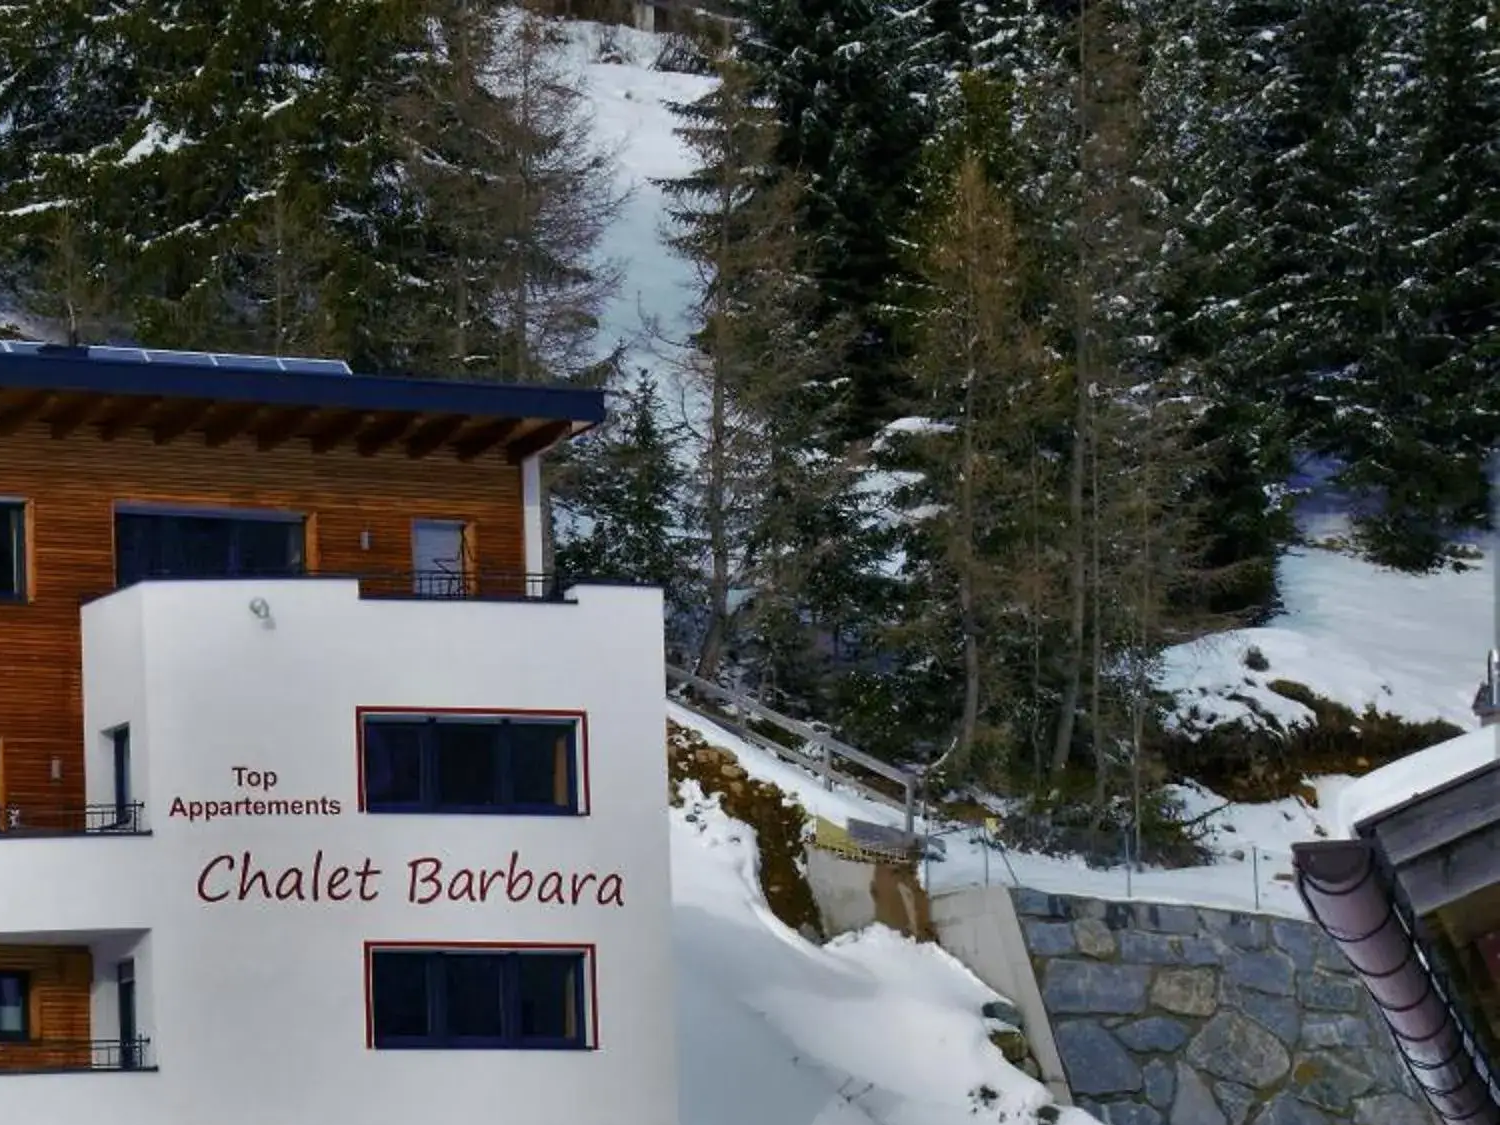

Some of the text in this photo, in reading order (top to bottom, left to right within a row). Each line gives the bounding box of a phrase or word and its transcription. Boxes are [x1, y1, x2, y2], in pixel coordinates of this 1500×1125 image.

[232, 766, 279, 793] Top
[169, 797, 342, 820] Appartements
[198, 850, 625, 907] Chalet Barbara
